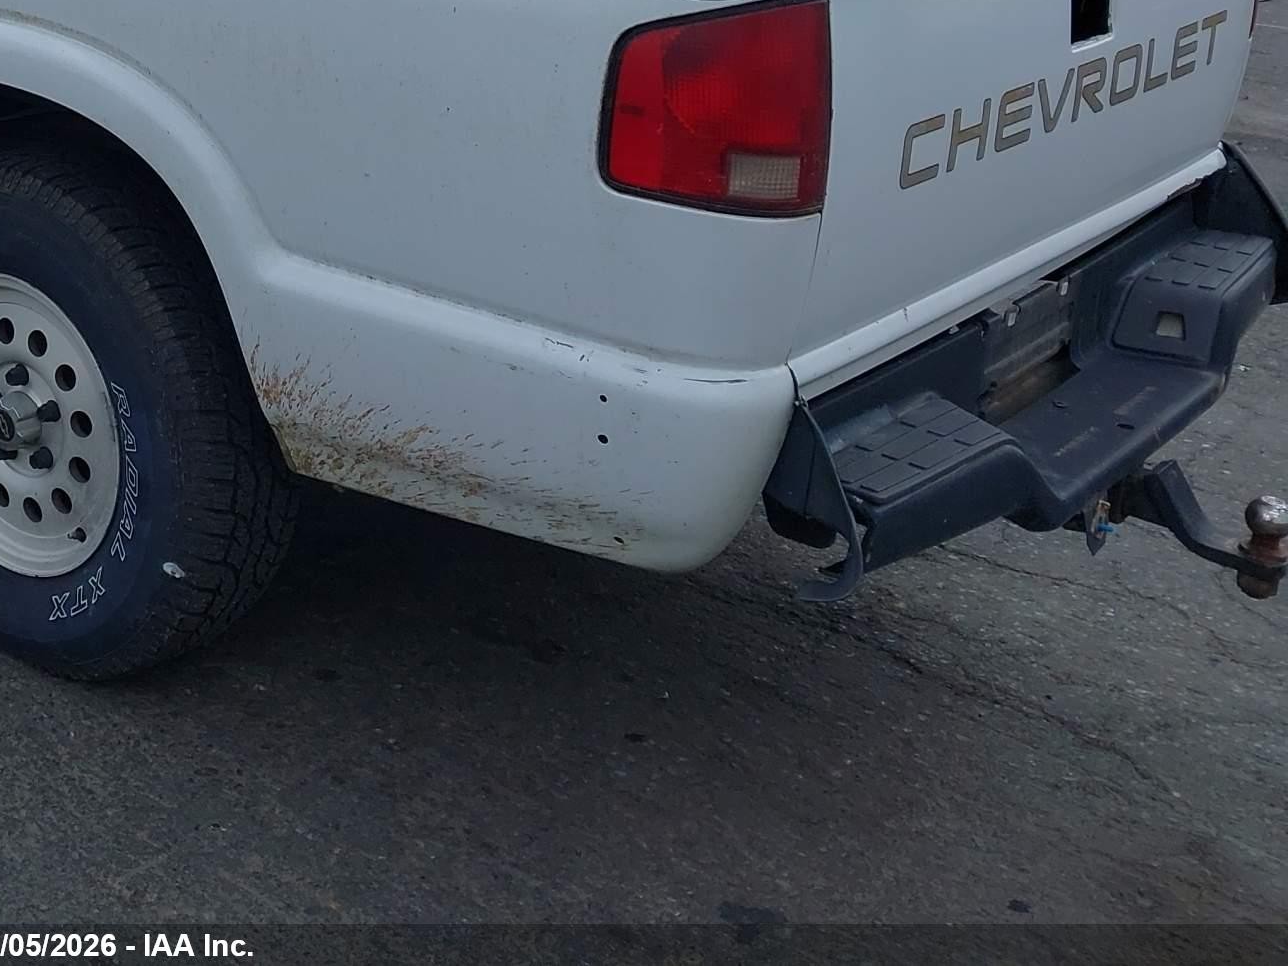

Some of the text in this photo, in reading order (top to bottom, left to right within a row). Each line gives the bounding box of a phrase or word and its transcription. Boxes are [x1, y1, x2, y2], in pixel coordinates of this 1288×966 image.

[898, 10, 1229, 191] CHEVROLET
[49, 381, 140, 621] RADIAL XTX
